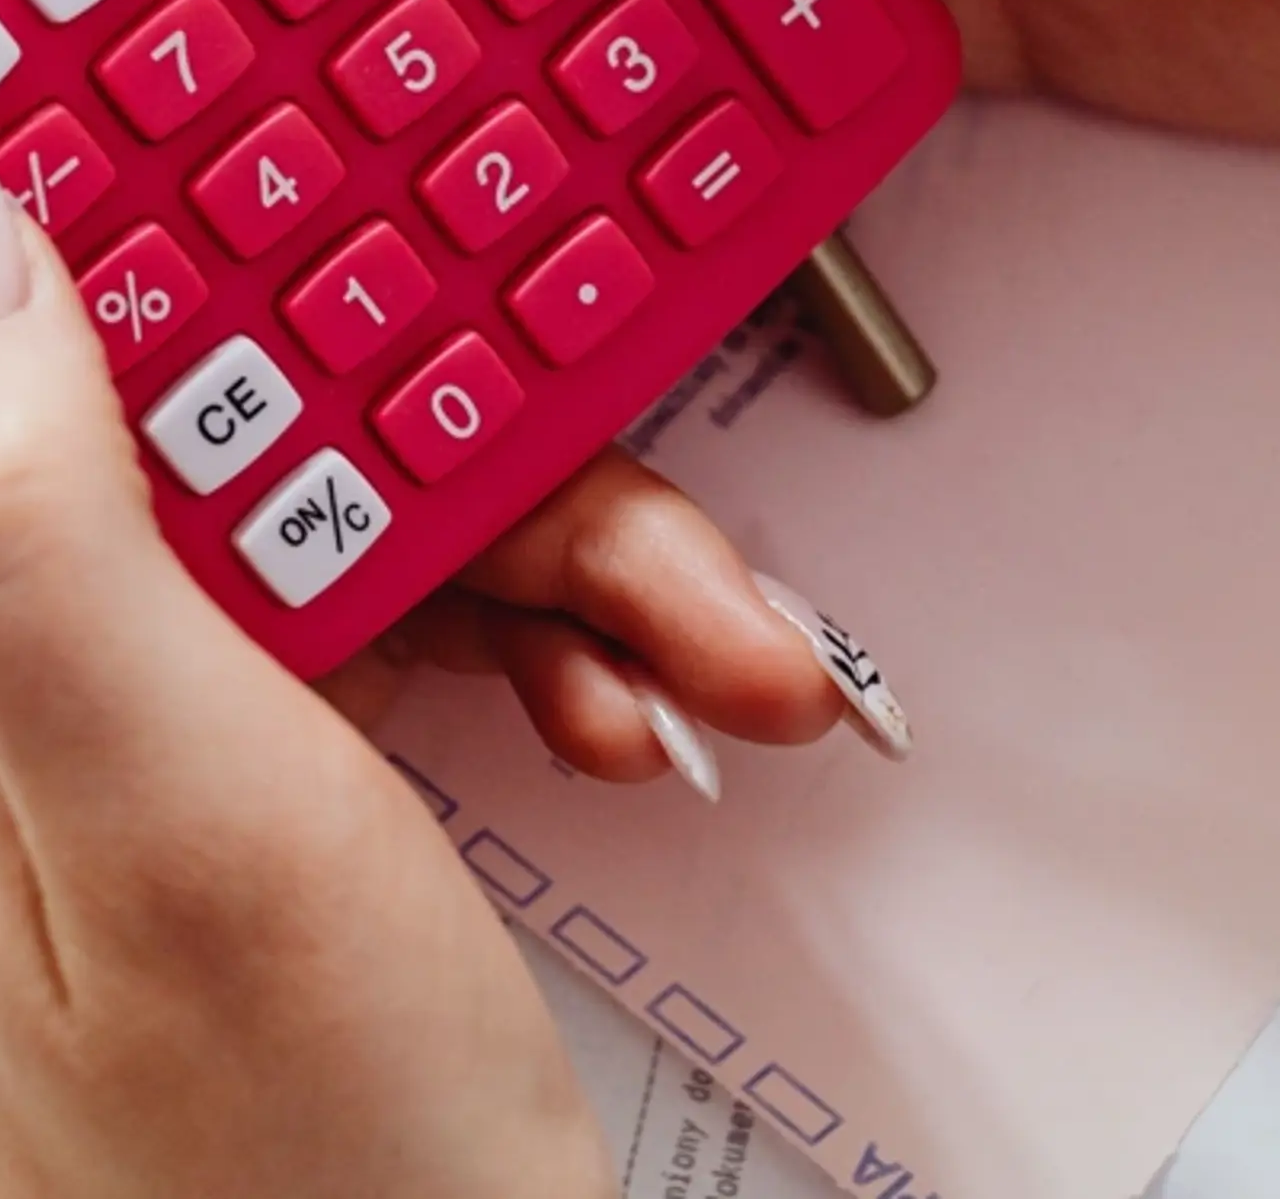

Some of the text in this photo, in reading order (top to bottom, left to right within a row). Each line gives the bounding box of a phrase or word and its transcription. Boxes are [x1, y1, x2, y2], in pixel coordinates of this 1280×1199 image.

[151, 30, 196, 93] 7
[383, 28, 437, 92] 5
[607, 37, 655, 92] 3
[259, 156, 298, 208] 4
[476, 152, 529, 212] 2
[95, 269, 172, 344] %
[344, 277, 385, 324] 1
[197, 376, 268, 446] CE
[432, 385, 479, 438] 0
